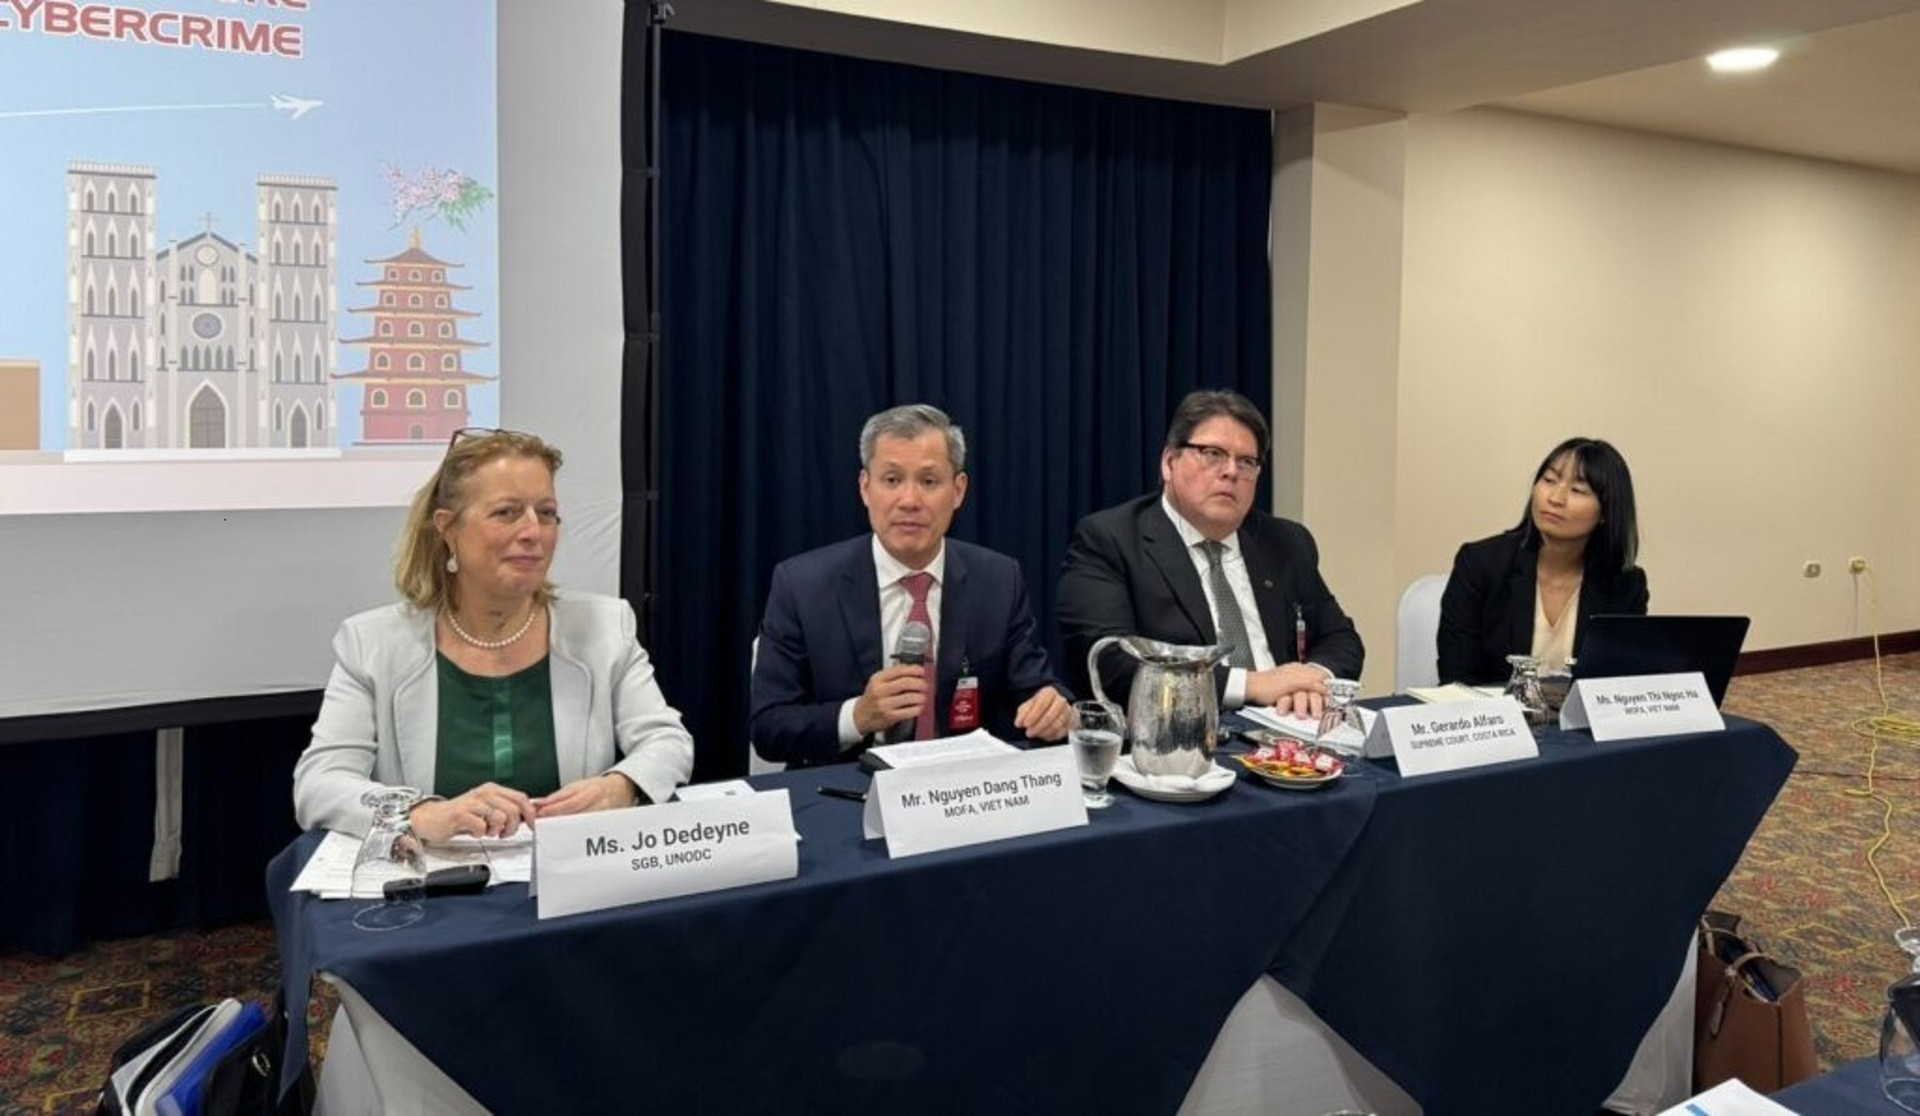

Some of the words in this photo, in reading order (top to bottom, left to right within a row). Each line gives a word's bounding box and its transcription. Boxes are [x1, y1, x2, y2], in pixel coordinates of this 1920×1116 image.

[1411, 723, 1429, 736] Mr.
[1430, 717, 1472, 734] Gerardo
[1473, 714, 1505, 729] Alfaro
[901, 793, 926, 809] Mr.
[928, 785, 981, 805] Nguyen
[983, 778, 1018, 796] Dang
[1019, 773, 1063, 789] Thang
[944, 804, 979, 818] MOFA,
[979, 799, 1002, 812] VIET
[1004, 795, 1030, 809] NAM
[585, 836, 625, 857] Ms.
[631, 831, 658, 851] Jo
[663, 820, 750, 846] Dedeyne
[631, 856, 663, 871] SGB,
[665, 847, 712, 866] UNODC
